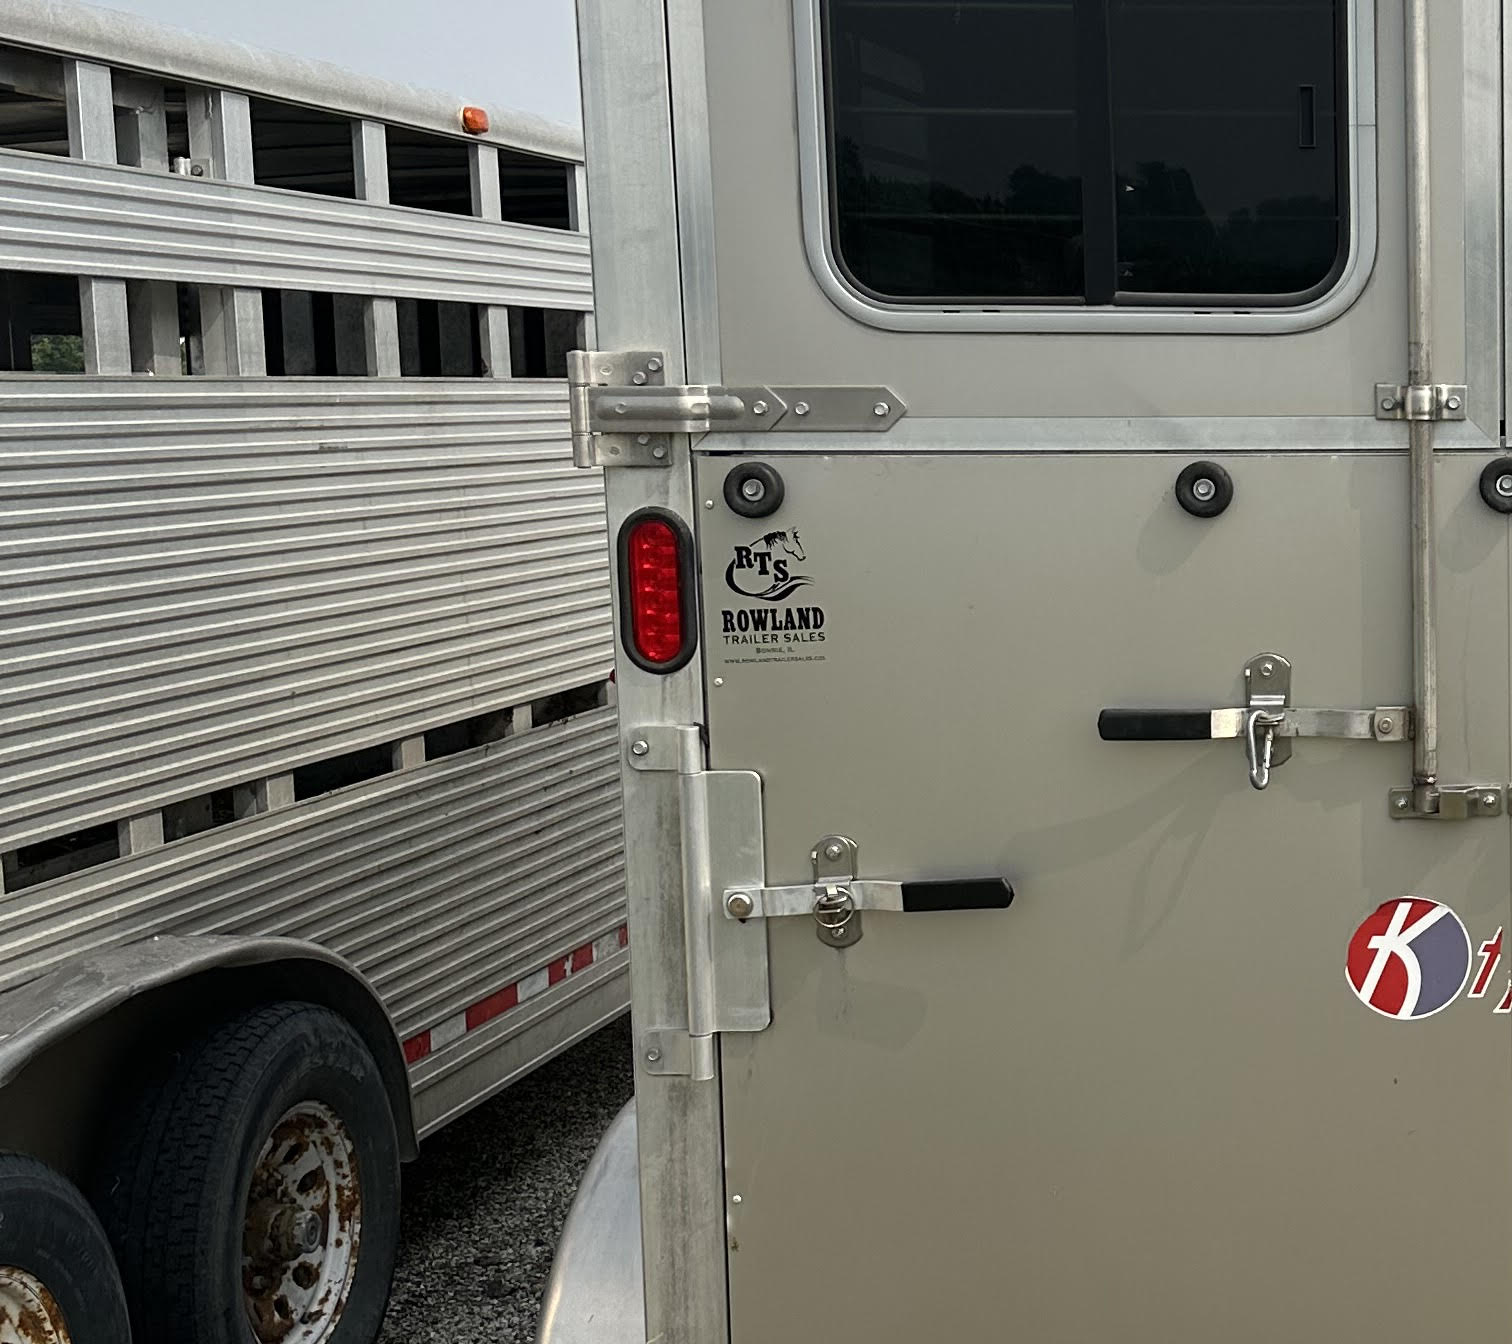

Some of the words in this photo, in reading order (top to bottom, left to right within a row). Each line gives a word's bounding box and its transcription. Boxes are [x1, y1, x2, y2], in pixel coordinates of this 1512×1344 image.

[734, 545, 789, 583] RTS
[721, 606, 825, 633] ROWLAND
[723, 634, 779, 645] TRAILER
[783, 631, 826, 643] SALES
